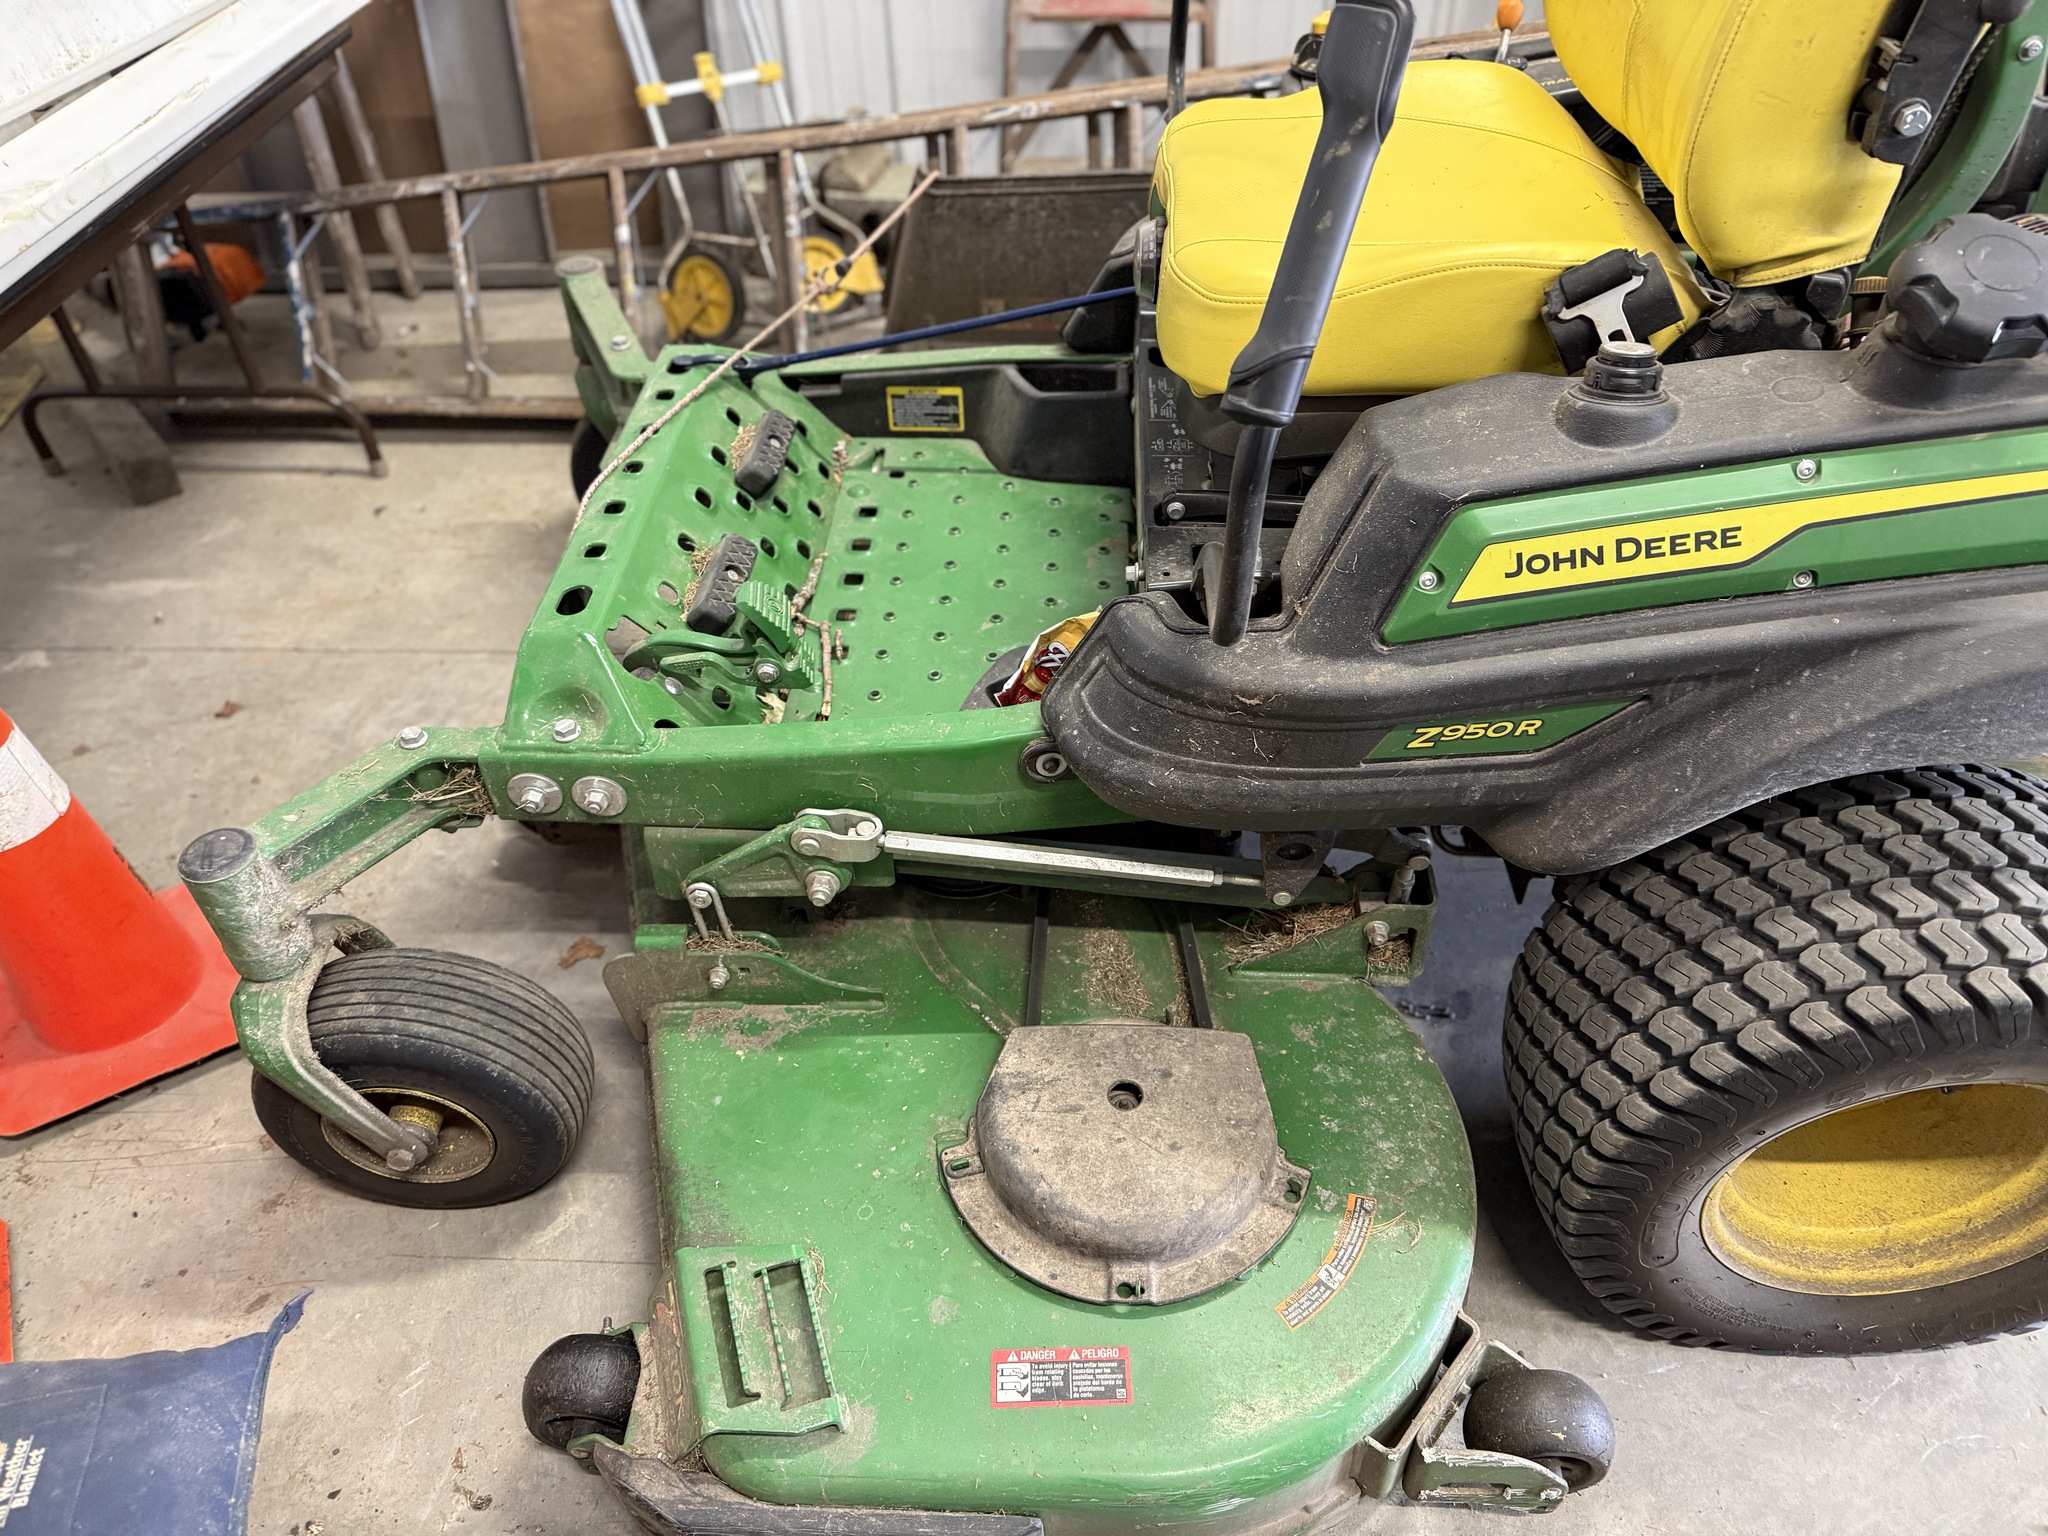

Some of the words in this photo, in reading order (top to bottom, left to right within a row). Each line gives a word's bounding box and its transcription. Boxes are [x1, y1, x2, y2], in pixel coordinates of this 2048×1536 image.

[1504, 545, 1604, 579] JOHN
[1615, 526, 1742, 563] DEERE
[1406, 719, 1543, 749] Z950R
[1289, 1280, 1314, 1303] WARNING
[1020, 1350, 1056, 1361] DANGER
[1081, 1348, 1119, 1359] PELIGRO
[10, 1446, 46, 1509] Blanket
